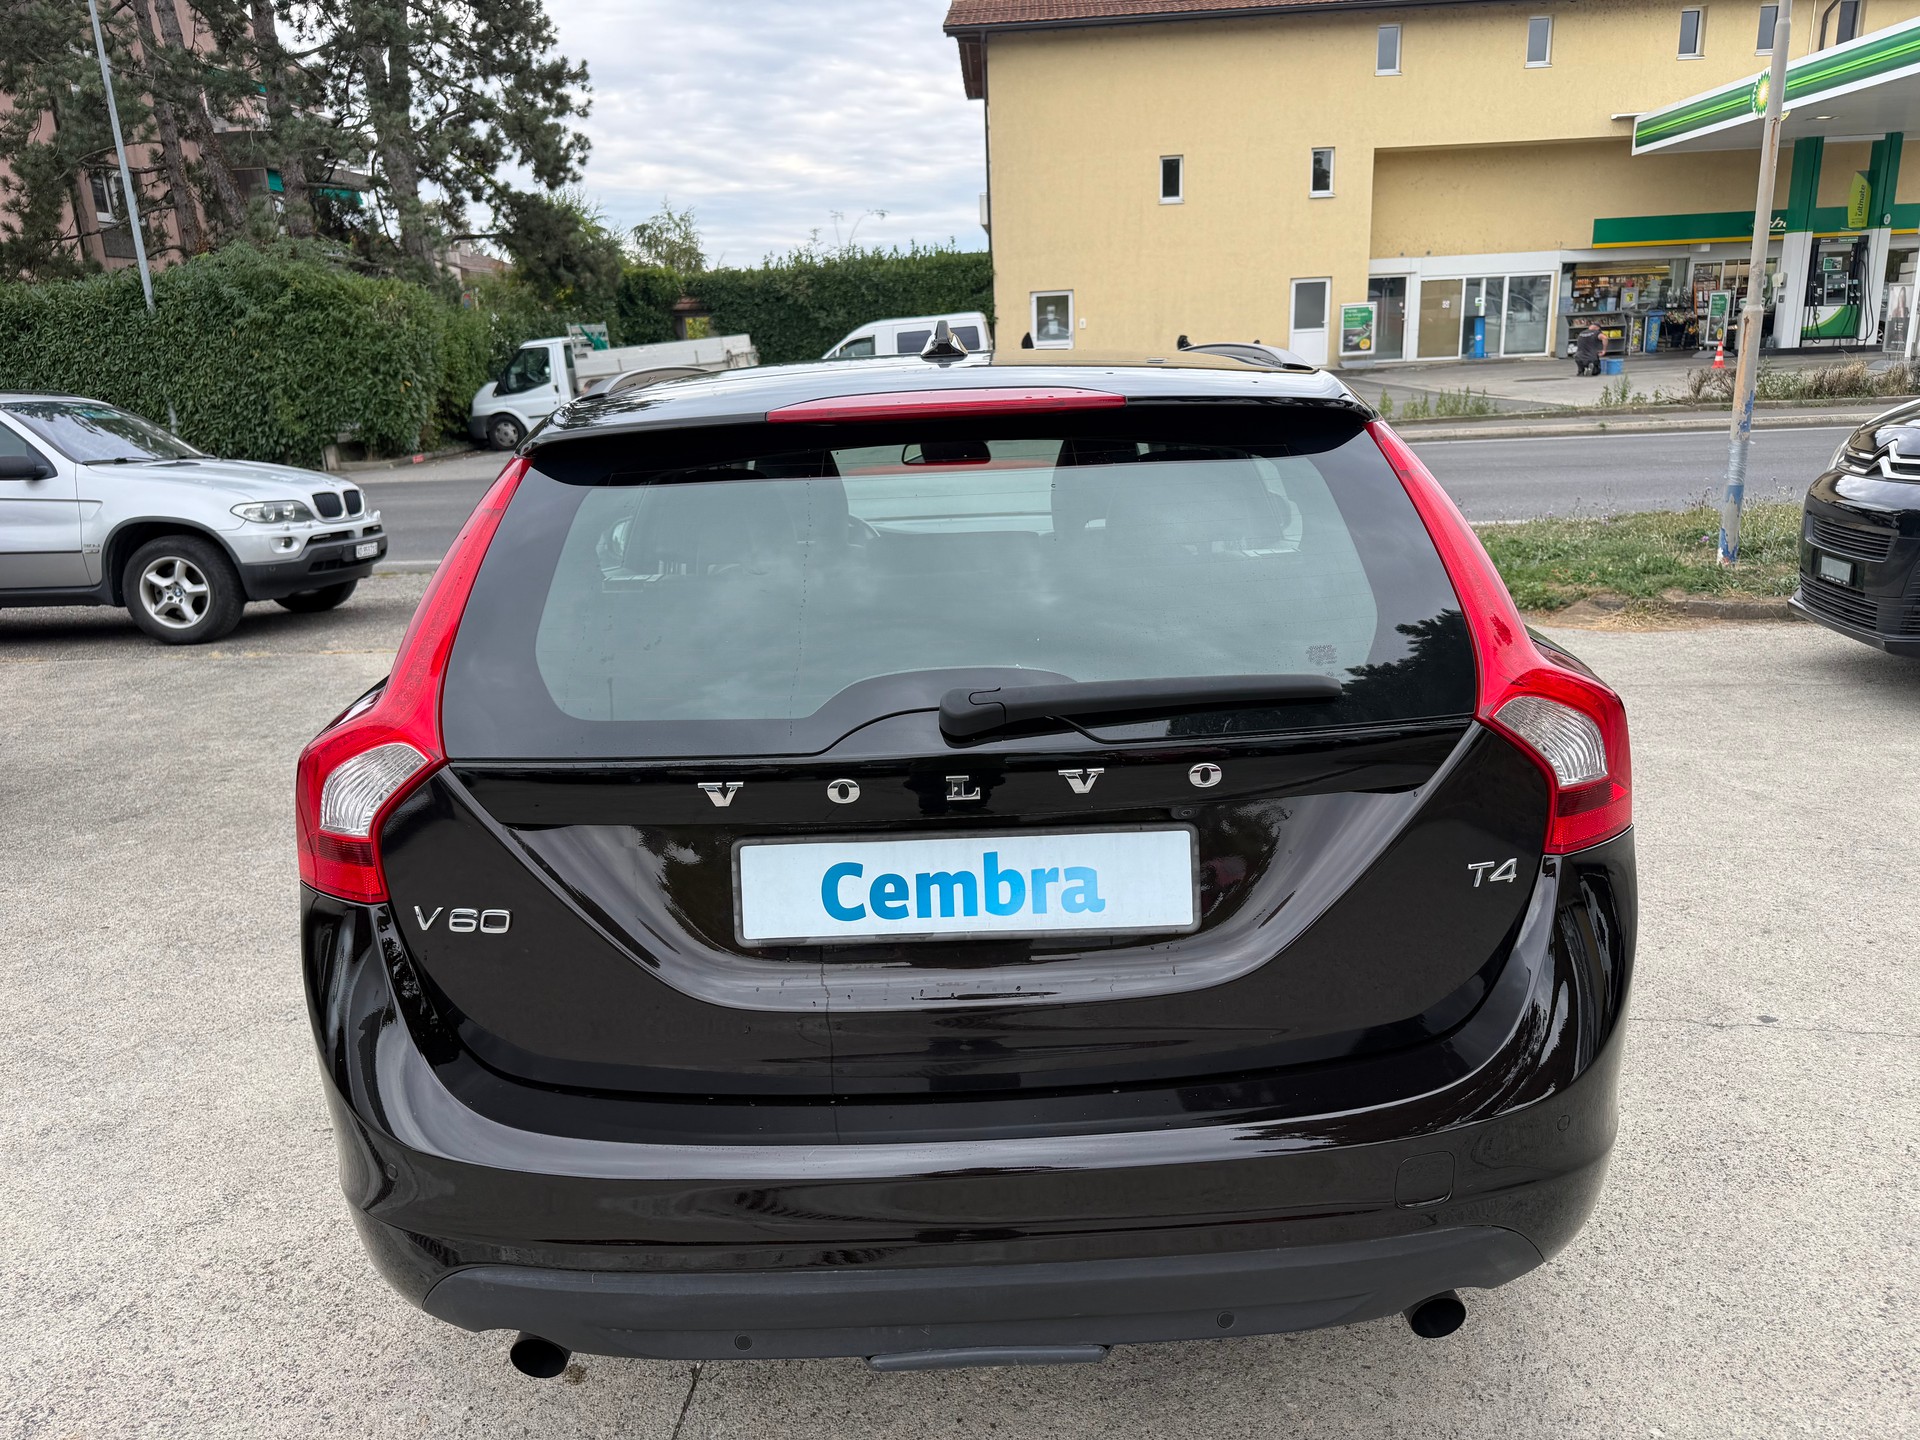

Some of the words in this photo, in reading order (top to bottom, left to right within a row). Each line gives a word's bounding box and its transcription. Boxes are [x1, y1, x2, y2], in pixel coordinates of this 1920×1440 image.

[1857, 184, 1866, 217] ultimate
[697, 762, 1222, 807] VOLVO
[820, 851, 1106, 922] Cembra
[1467, 857, 1518, 888] T4
[413, 905, 513, 934] V60
